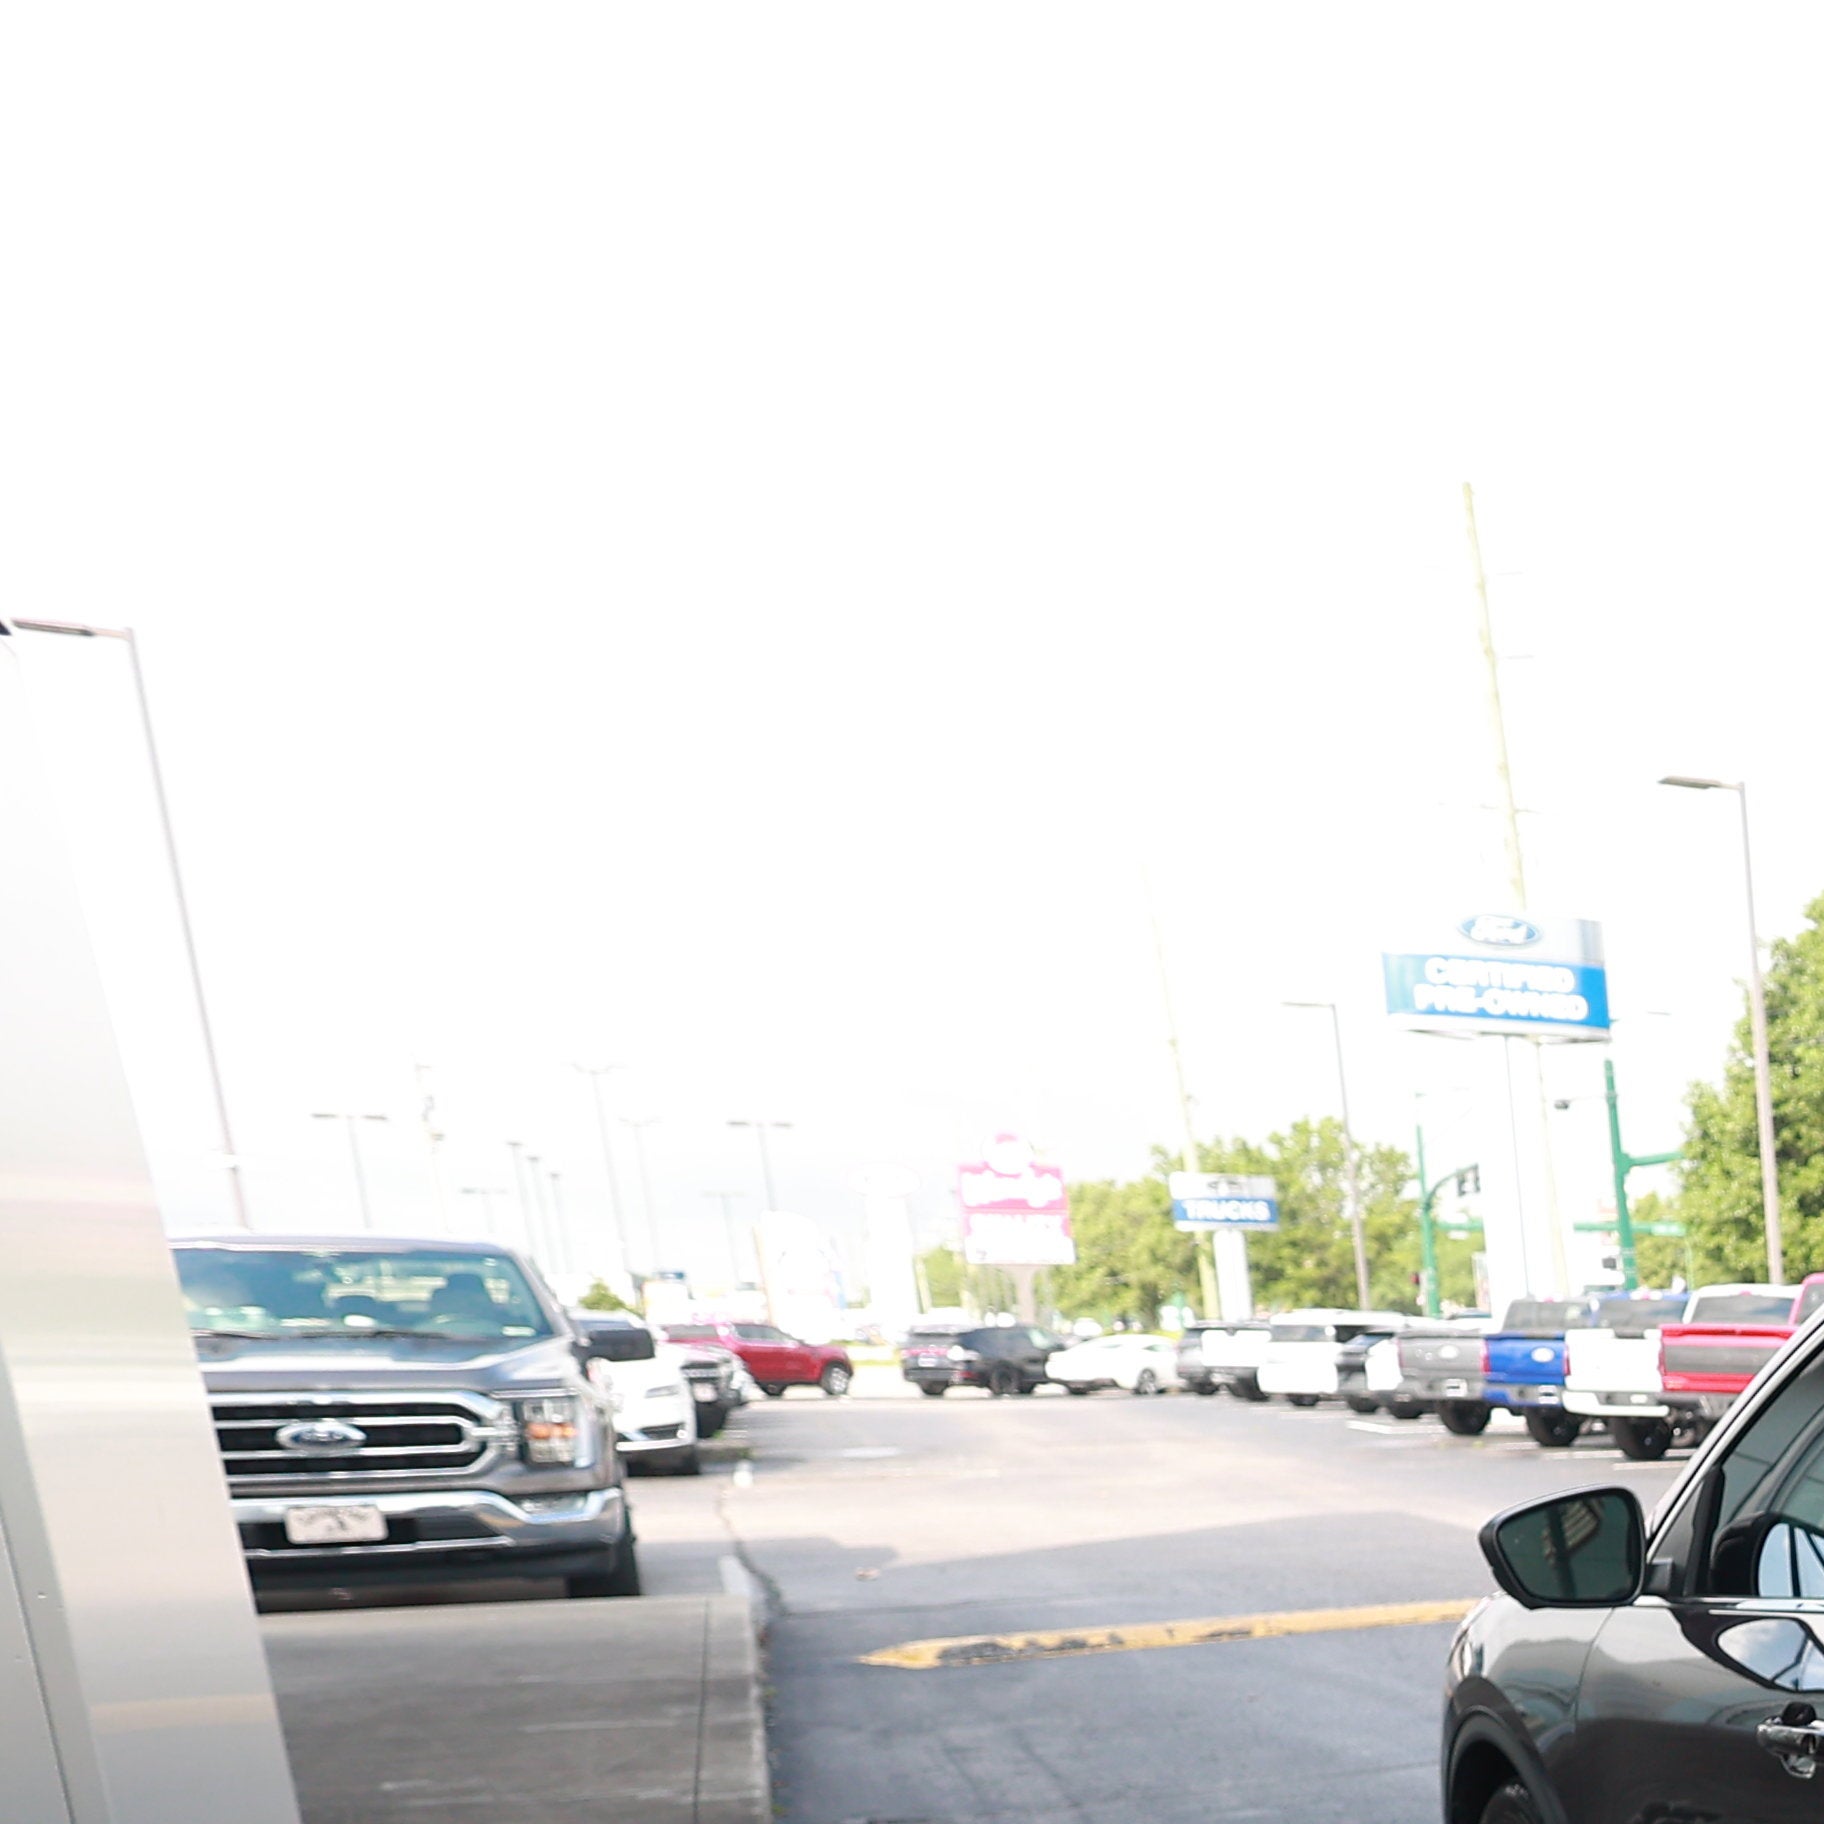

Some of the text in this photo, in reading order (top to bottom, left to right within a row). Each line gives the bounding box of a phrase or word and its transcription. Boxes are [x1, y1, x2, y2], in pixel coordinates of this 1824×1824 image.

[1425, 956, 1575, 993] CERTIFIED
[1413, 983, 1590, 1021] PRE-OWNED
[1182, 1199, 1270, 1221] TRUCKS
